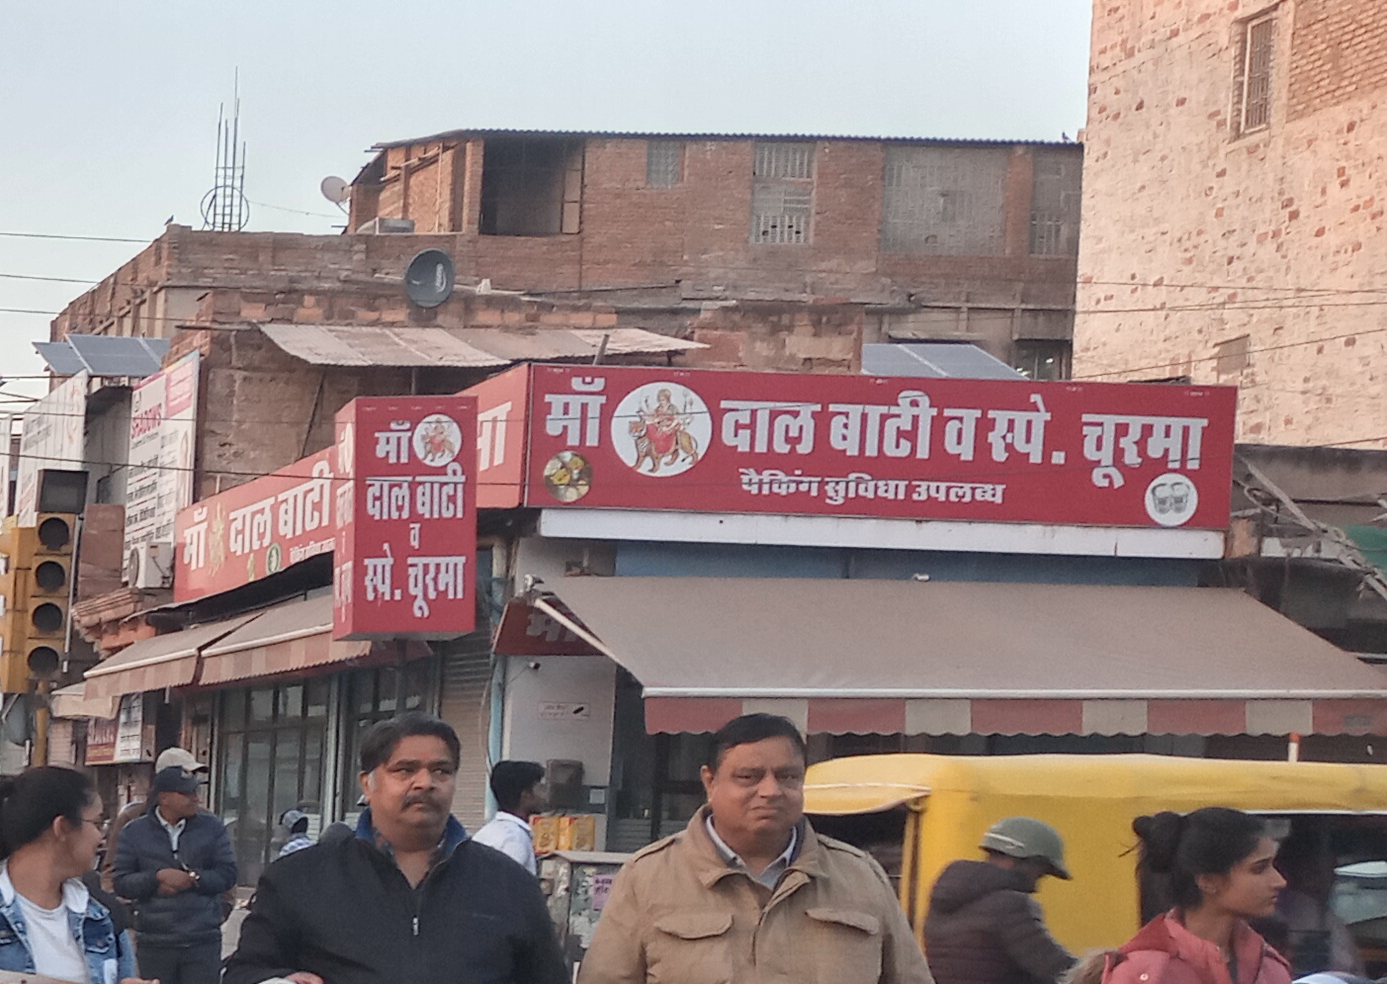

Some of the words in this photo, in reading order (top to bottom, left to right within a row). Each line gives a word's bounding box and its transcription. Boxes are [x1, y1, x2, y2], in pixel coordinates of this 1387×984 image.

[374, 421, 412, 465] माँ
[544, 377, 607, 447] माँ
[720, 399, 822, 455] दाल
[829, 389, 938, 460] बाटी
[943, 408, 982, 461] व
[987, 393, 1066, 465] स्पे.
[1081, 413, 1209, 489] चूरमा
[183, 503, 208, 571] माँ
[228, 497, 276, 556] दाल
[277, 461, 334, 540] बाटी
[365, 476, 414, 520] दाल
[413, 462, 467, 519] बाटी
[739, 468, 822, 498] पैकिंग
[824, 472, 908, 506] सुविधा
[911, 480, 1006, 504] उपलब्ध
[410, 523, 421, 549] व
[407, 556, 467, 619] चूरमा
